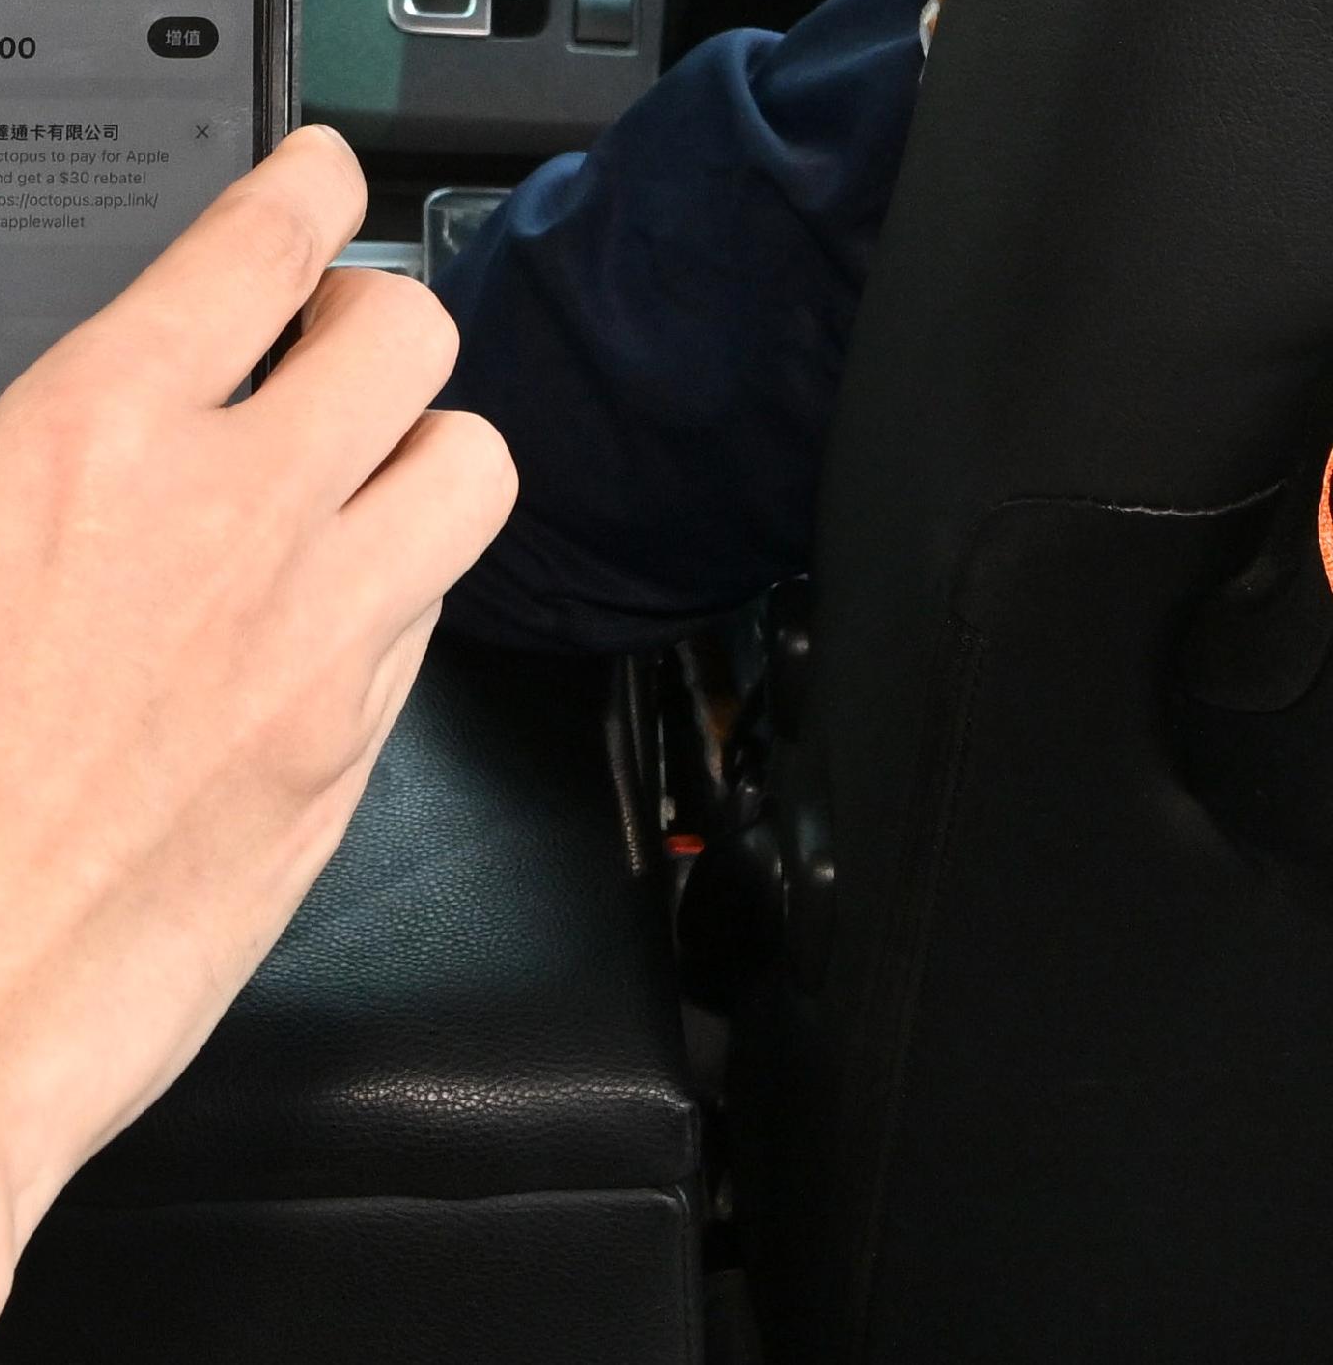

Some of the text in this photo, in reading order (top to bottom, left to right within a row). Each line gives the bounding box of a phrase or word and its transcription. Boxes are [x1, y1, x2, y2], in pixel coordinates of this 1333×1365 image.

[165, 29, 202, 48] 增值
[51, 150, 65, 163] to
[70, 153, 95, 167] pay
[101, 149, 121, 163] for
[126, 149, 170, 166] Apple
[17, 172, 42, 187] get
[46, 174, 55, 185] a
[60, 170, 90, 186] $30
